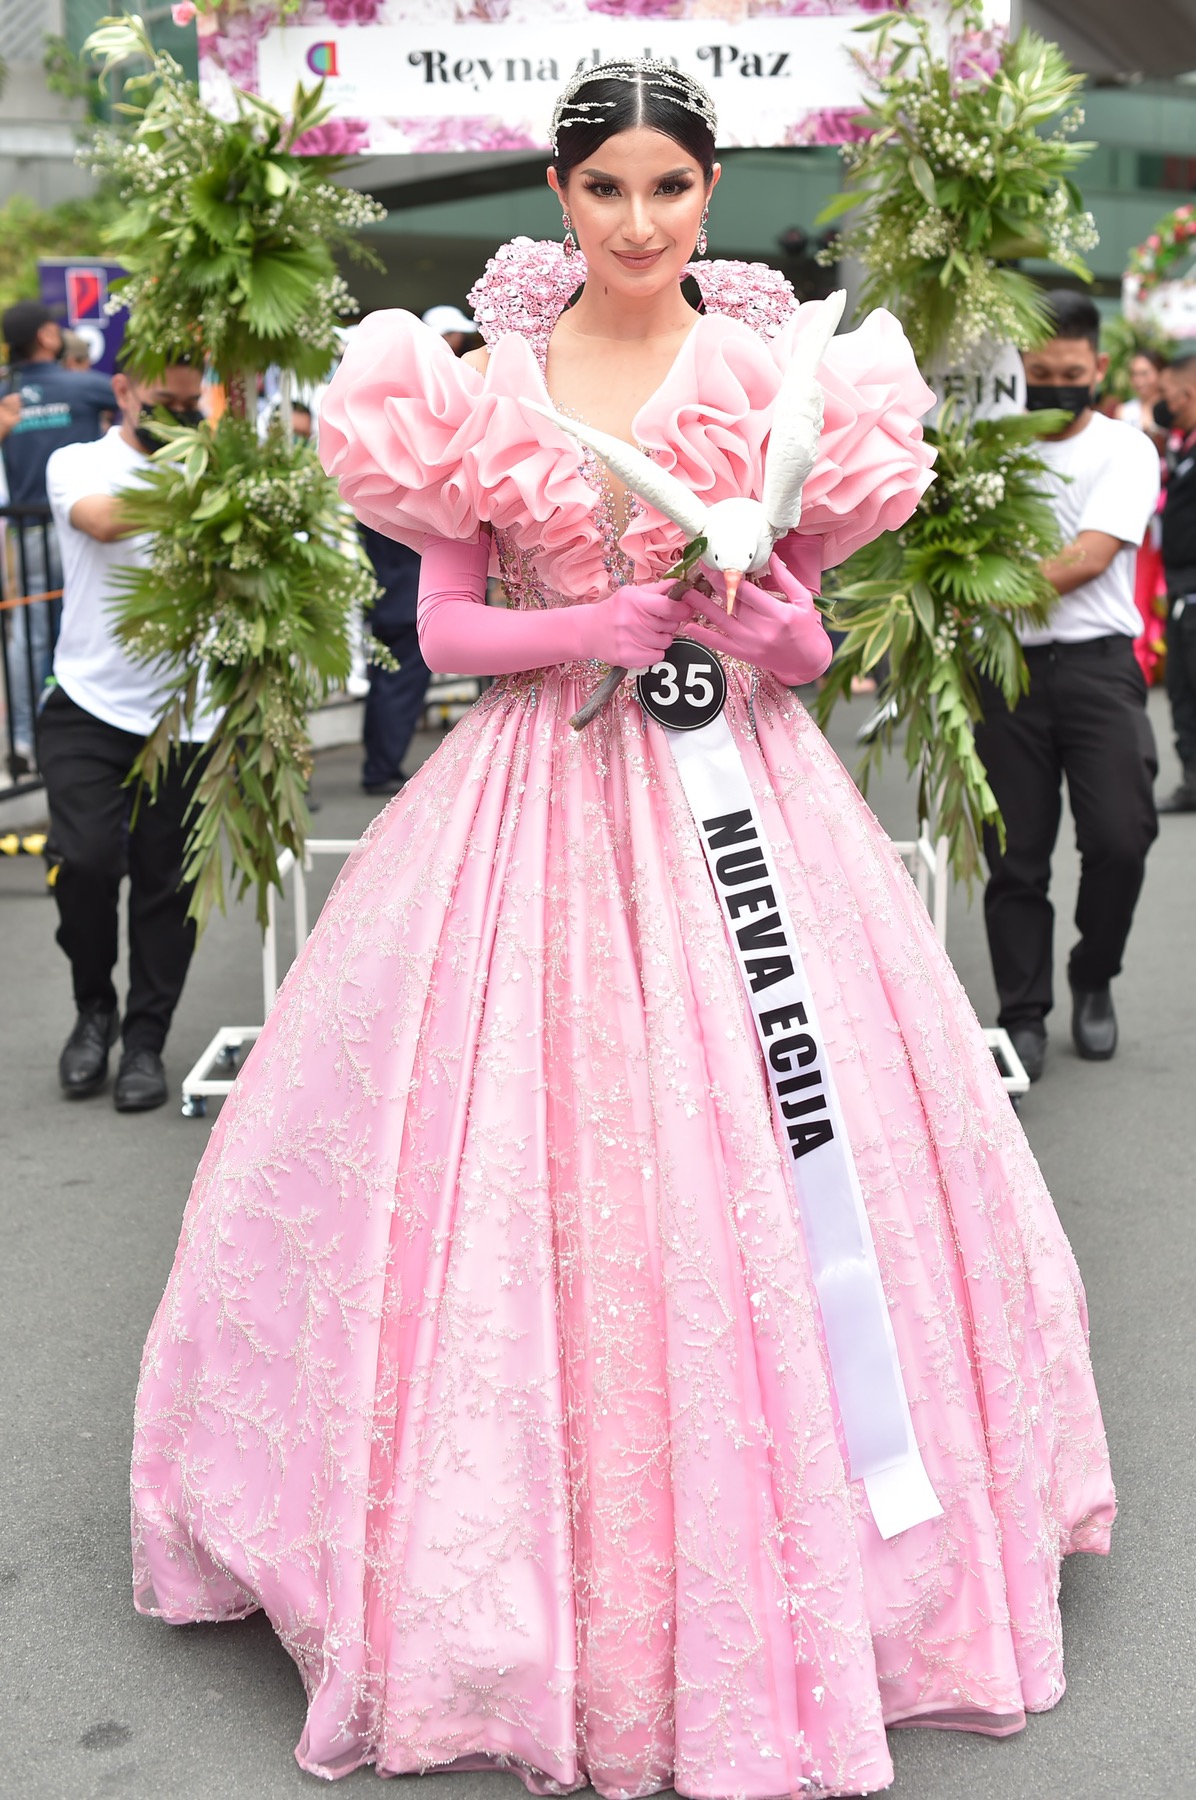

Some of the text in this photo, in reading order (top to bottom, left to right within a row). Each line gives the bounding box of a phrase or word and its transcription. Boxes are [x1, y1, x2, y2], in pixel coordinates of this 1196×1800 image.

[408, 49, 560, 92] Reyna
[696, 45, 792, 78] Paz
[926, 374, 1017, 404] EIN
[650, 661, 715, 708] 35
[702, 808, 835, 1160] NUEVA ECIJA
